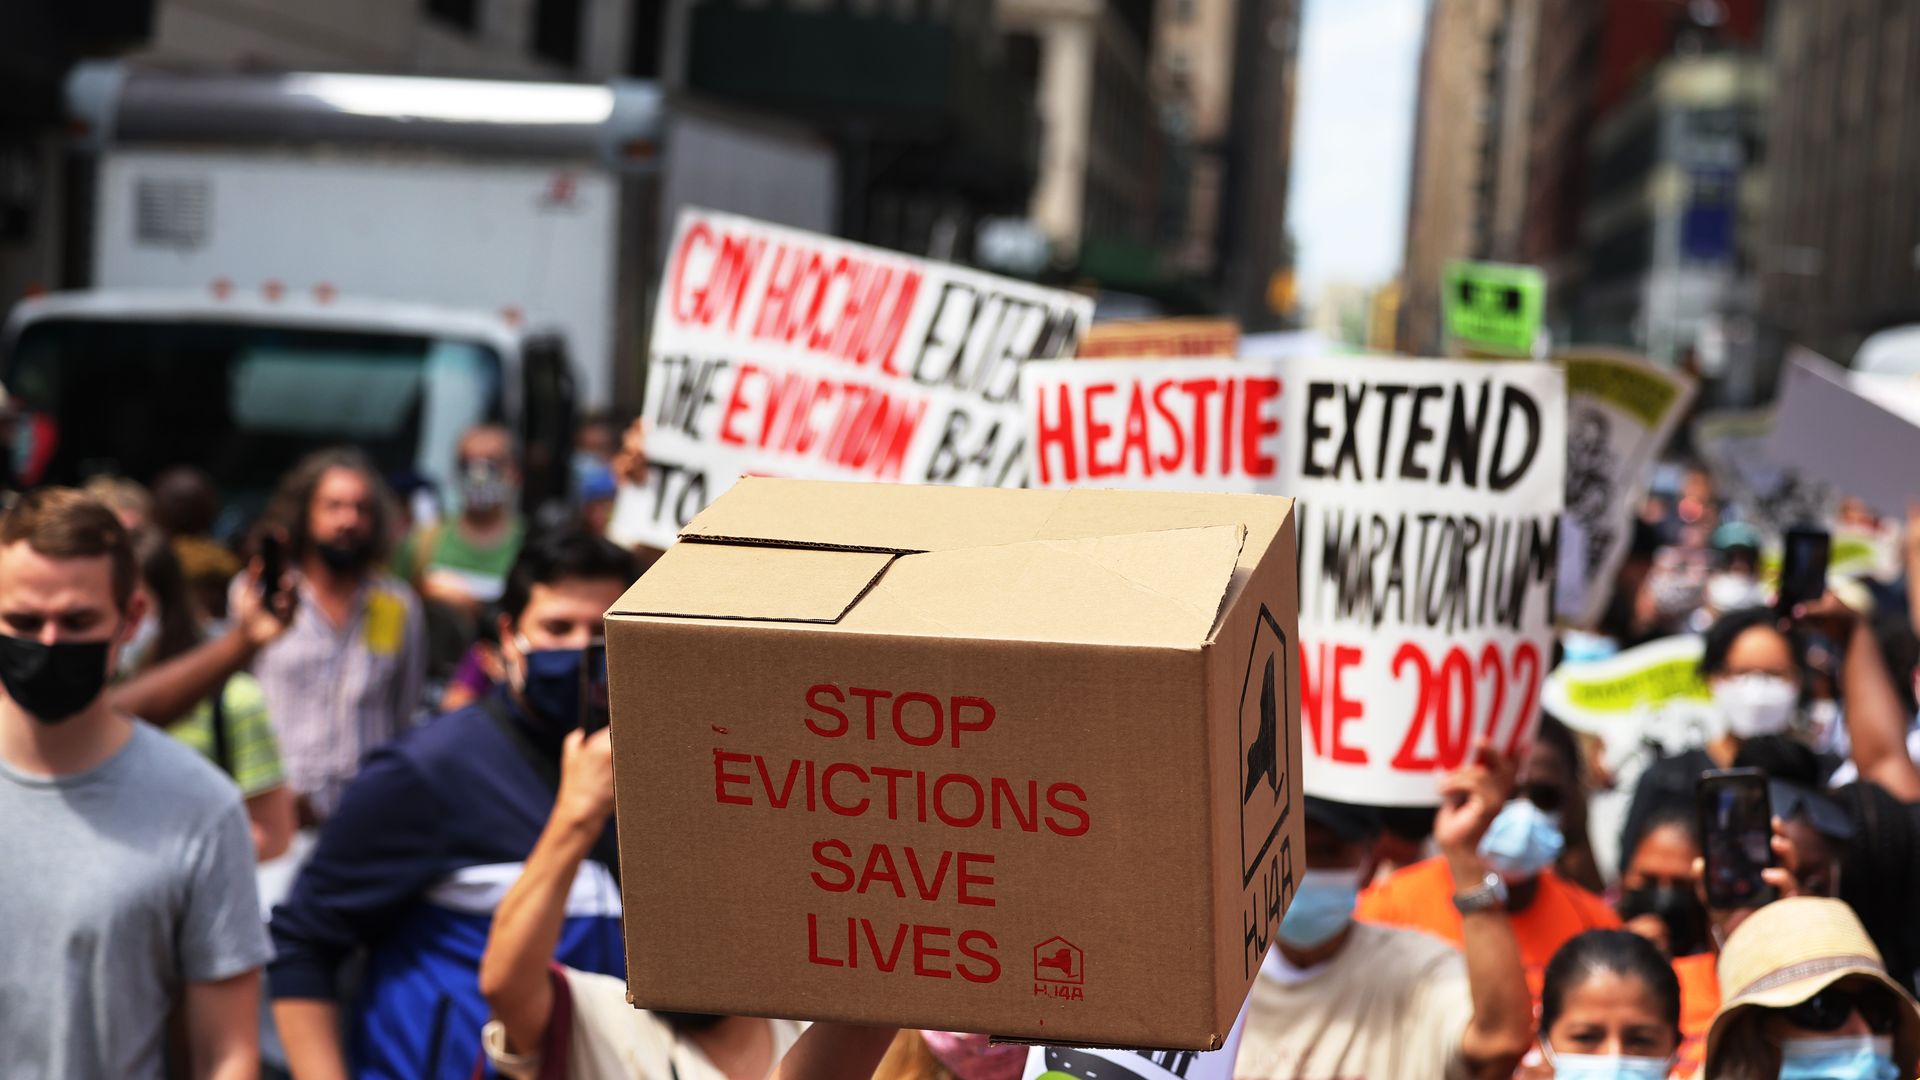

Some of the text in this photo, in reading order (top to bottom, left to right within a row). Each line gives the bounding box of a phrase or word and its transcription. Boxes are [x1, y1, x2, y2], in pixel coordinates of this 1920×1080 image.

[655, 356, 728, 439] THE
[719, 363, 927, 480] EVICTION
[1037, 376, 1284, 485] HEASTIE
[1302, 376, 1541, 492] EXTEND
[645, 458, 708, 530] TO
[804, 683, 996, 748] STOP
[1300, 640, 1539, 772] NE 2022
[713, 748, 1090, 837] EVICTIONS
[810, 838, 996, 906] SAVE
[1244, 835, 1293, 980] HJ4A
[807, 914, 1001, 984] LIVES
